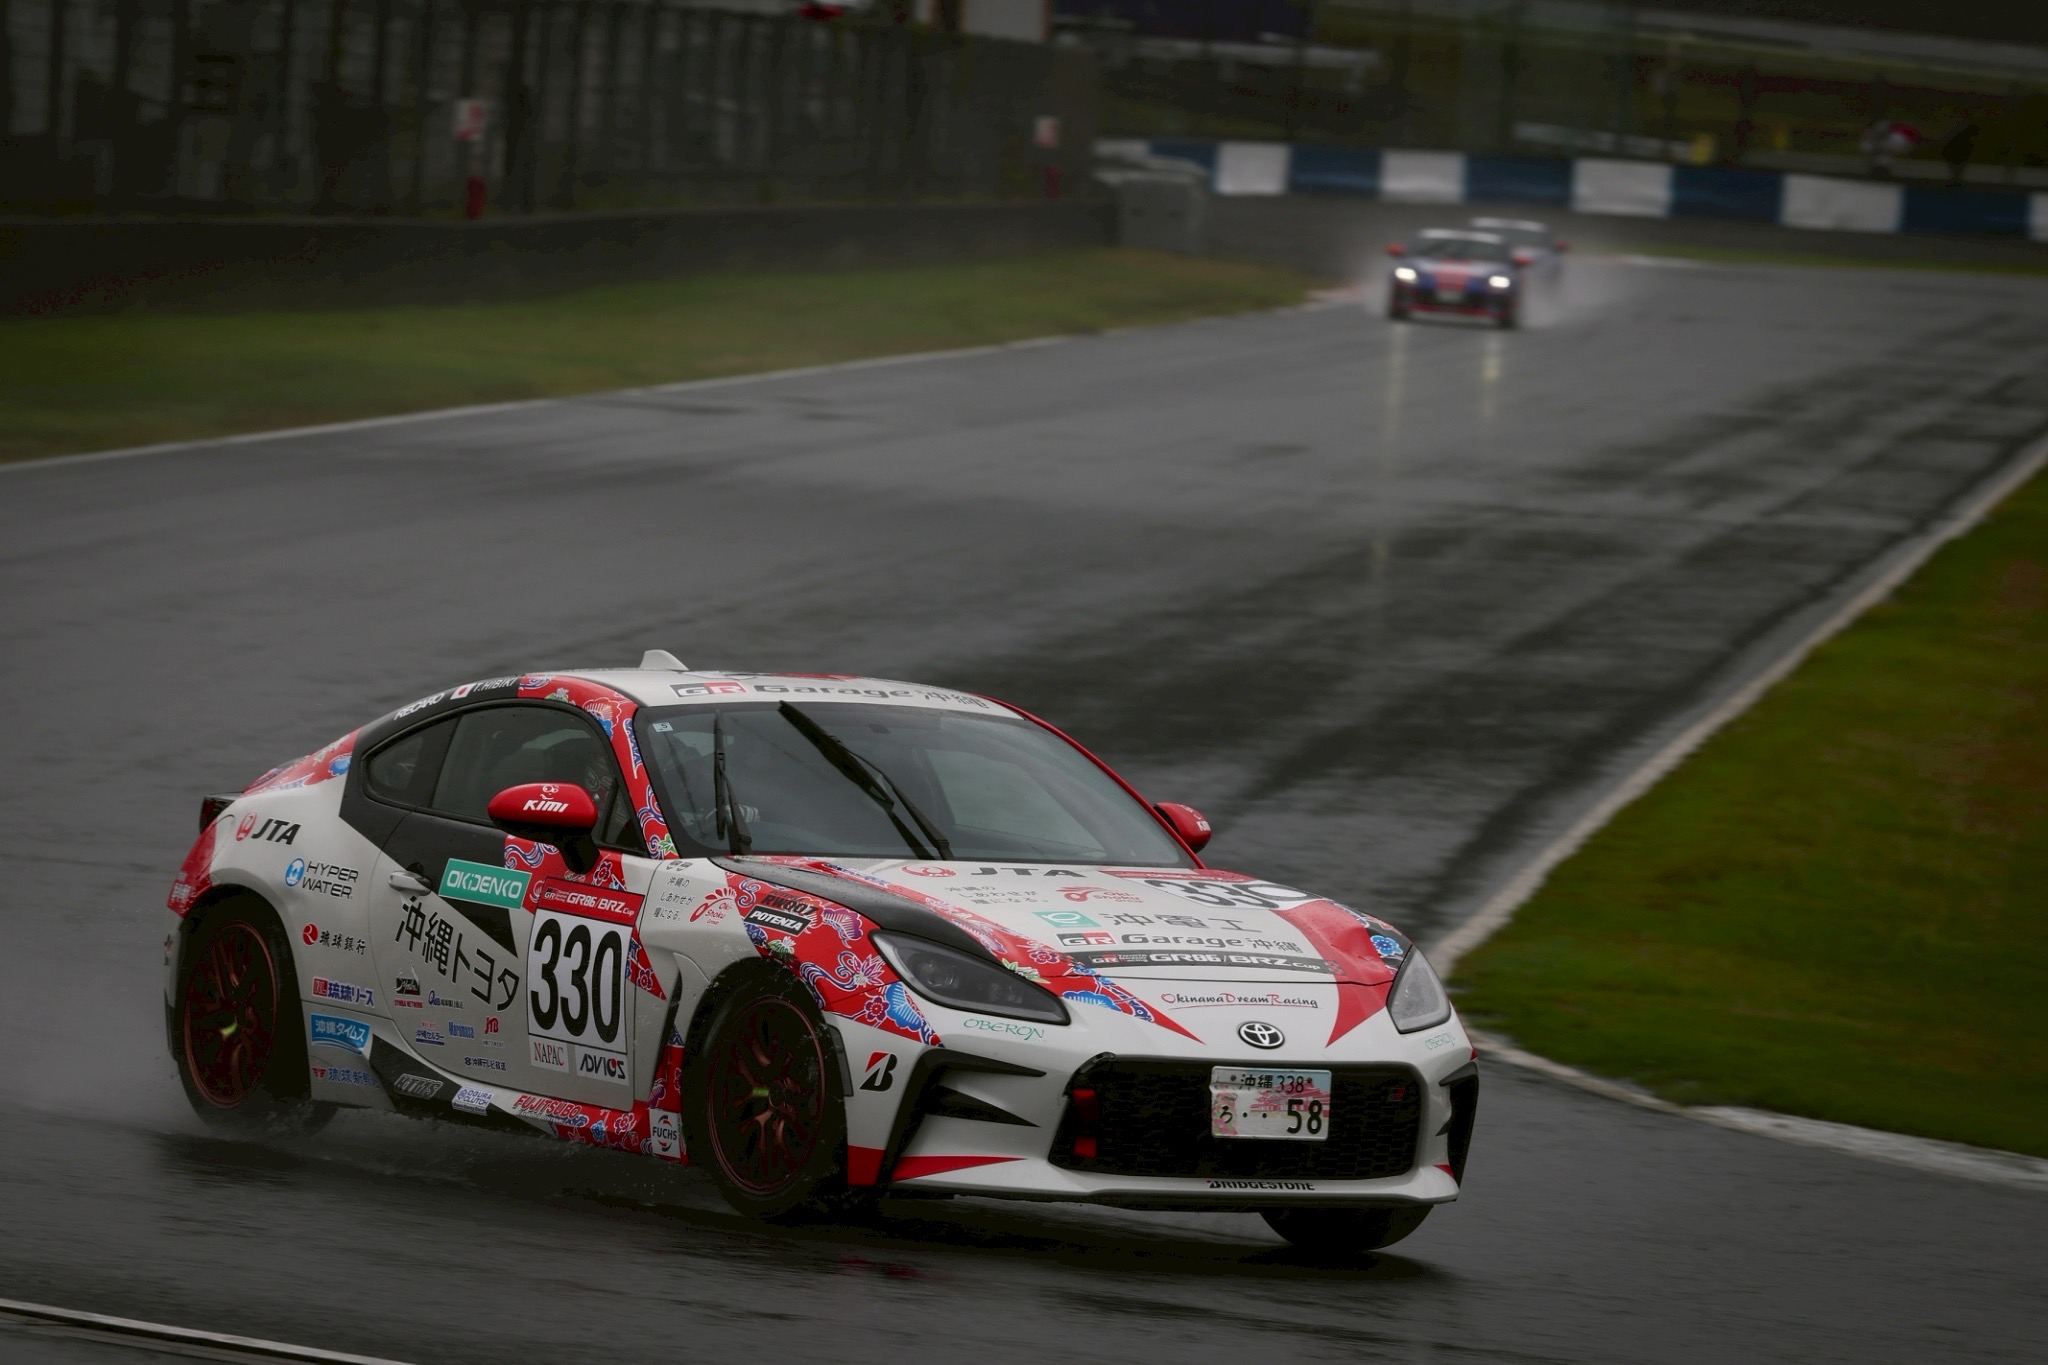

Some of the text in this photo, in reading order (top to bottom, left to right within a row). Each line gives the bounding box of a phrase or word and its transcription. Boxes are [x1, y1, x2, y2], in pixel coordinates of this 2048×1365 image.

[473, 677, 520, 692] T.HIBIKI
[674, 682, 746, 697] GR
[753, 684, 914, 698] Garage
[394, 693, 445, 720] RECARO
[251, 818, 302, 845] JTA
[306, 860, 359, 883] HYPER
[970, 867, 1087, 878] JTA
[302, 877, 352, 899] WATER
[1144, 879, 1323, 909] 330
[566, 892, 626, 913] GR86/BRZ
[622, 907, 635, 917] Cup
[750, 910, 803, 931] POTENZA
[1099, 913, 1263, 933] 沖電工
[320, 930, 366, 955] 琉球銀行
[1060, 933, 1116, 946] GR
[1121, 933, 1244, 948] Garage
[395, 896, 520, 1011] 沖縄トヨタ
[1149, 953, 1293, 966] GR86/BRZ
[1291, 962, 1321, 970] Cup
[530, 918, 622, 1043] 330
[328, 982, 374, 1006] 琉球リース
[315, 1020, 366, 1042] 沖縄タイムス
[485, 1017, 499, 1034] JTB
[963, 1018, 1044, 1041] OBERON
[534, 1042, 565, 1066] NAPAC
[467, 1089, 493, 1100] OGURA
[1240, 1074, 1304, 1093] 沖縄 338
[463, 1096, 489, 1106] CLUTCH
[513, 1095, 582, 1118] FUJITSUBO
[1219, 1098, 1323, 1134] ろ 58
[652, 1126, 677, 1141] FUCHS
[1206, 1180, 1315, 1191] BRIDGESTONE
